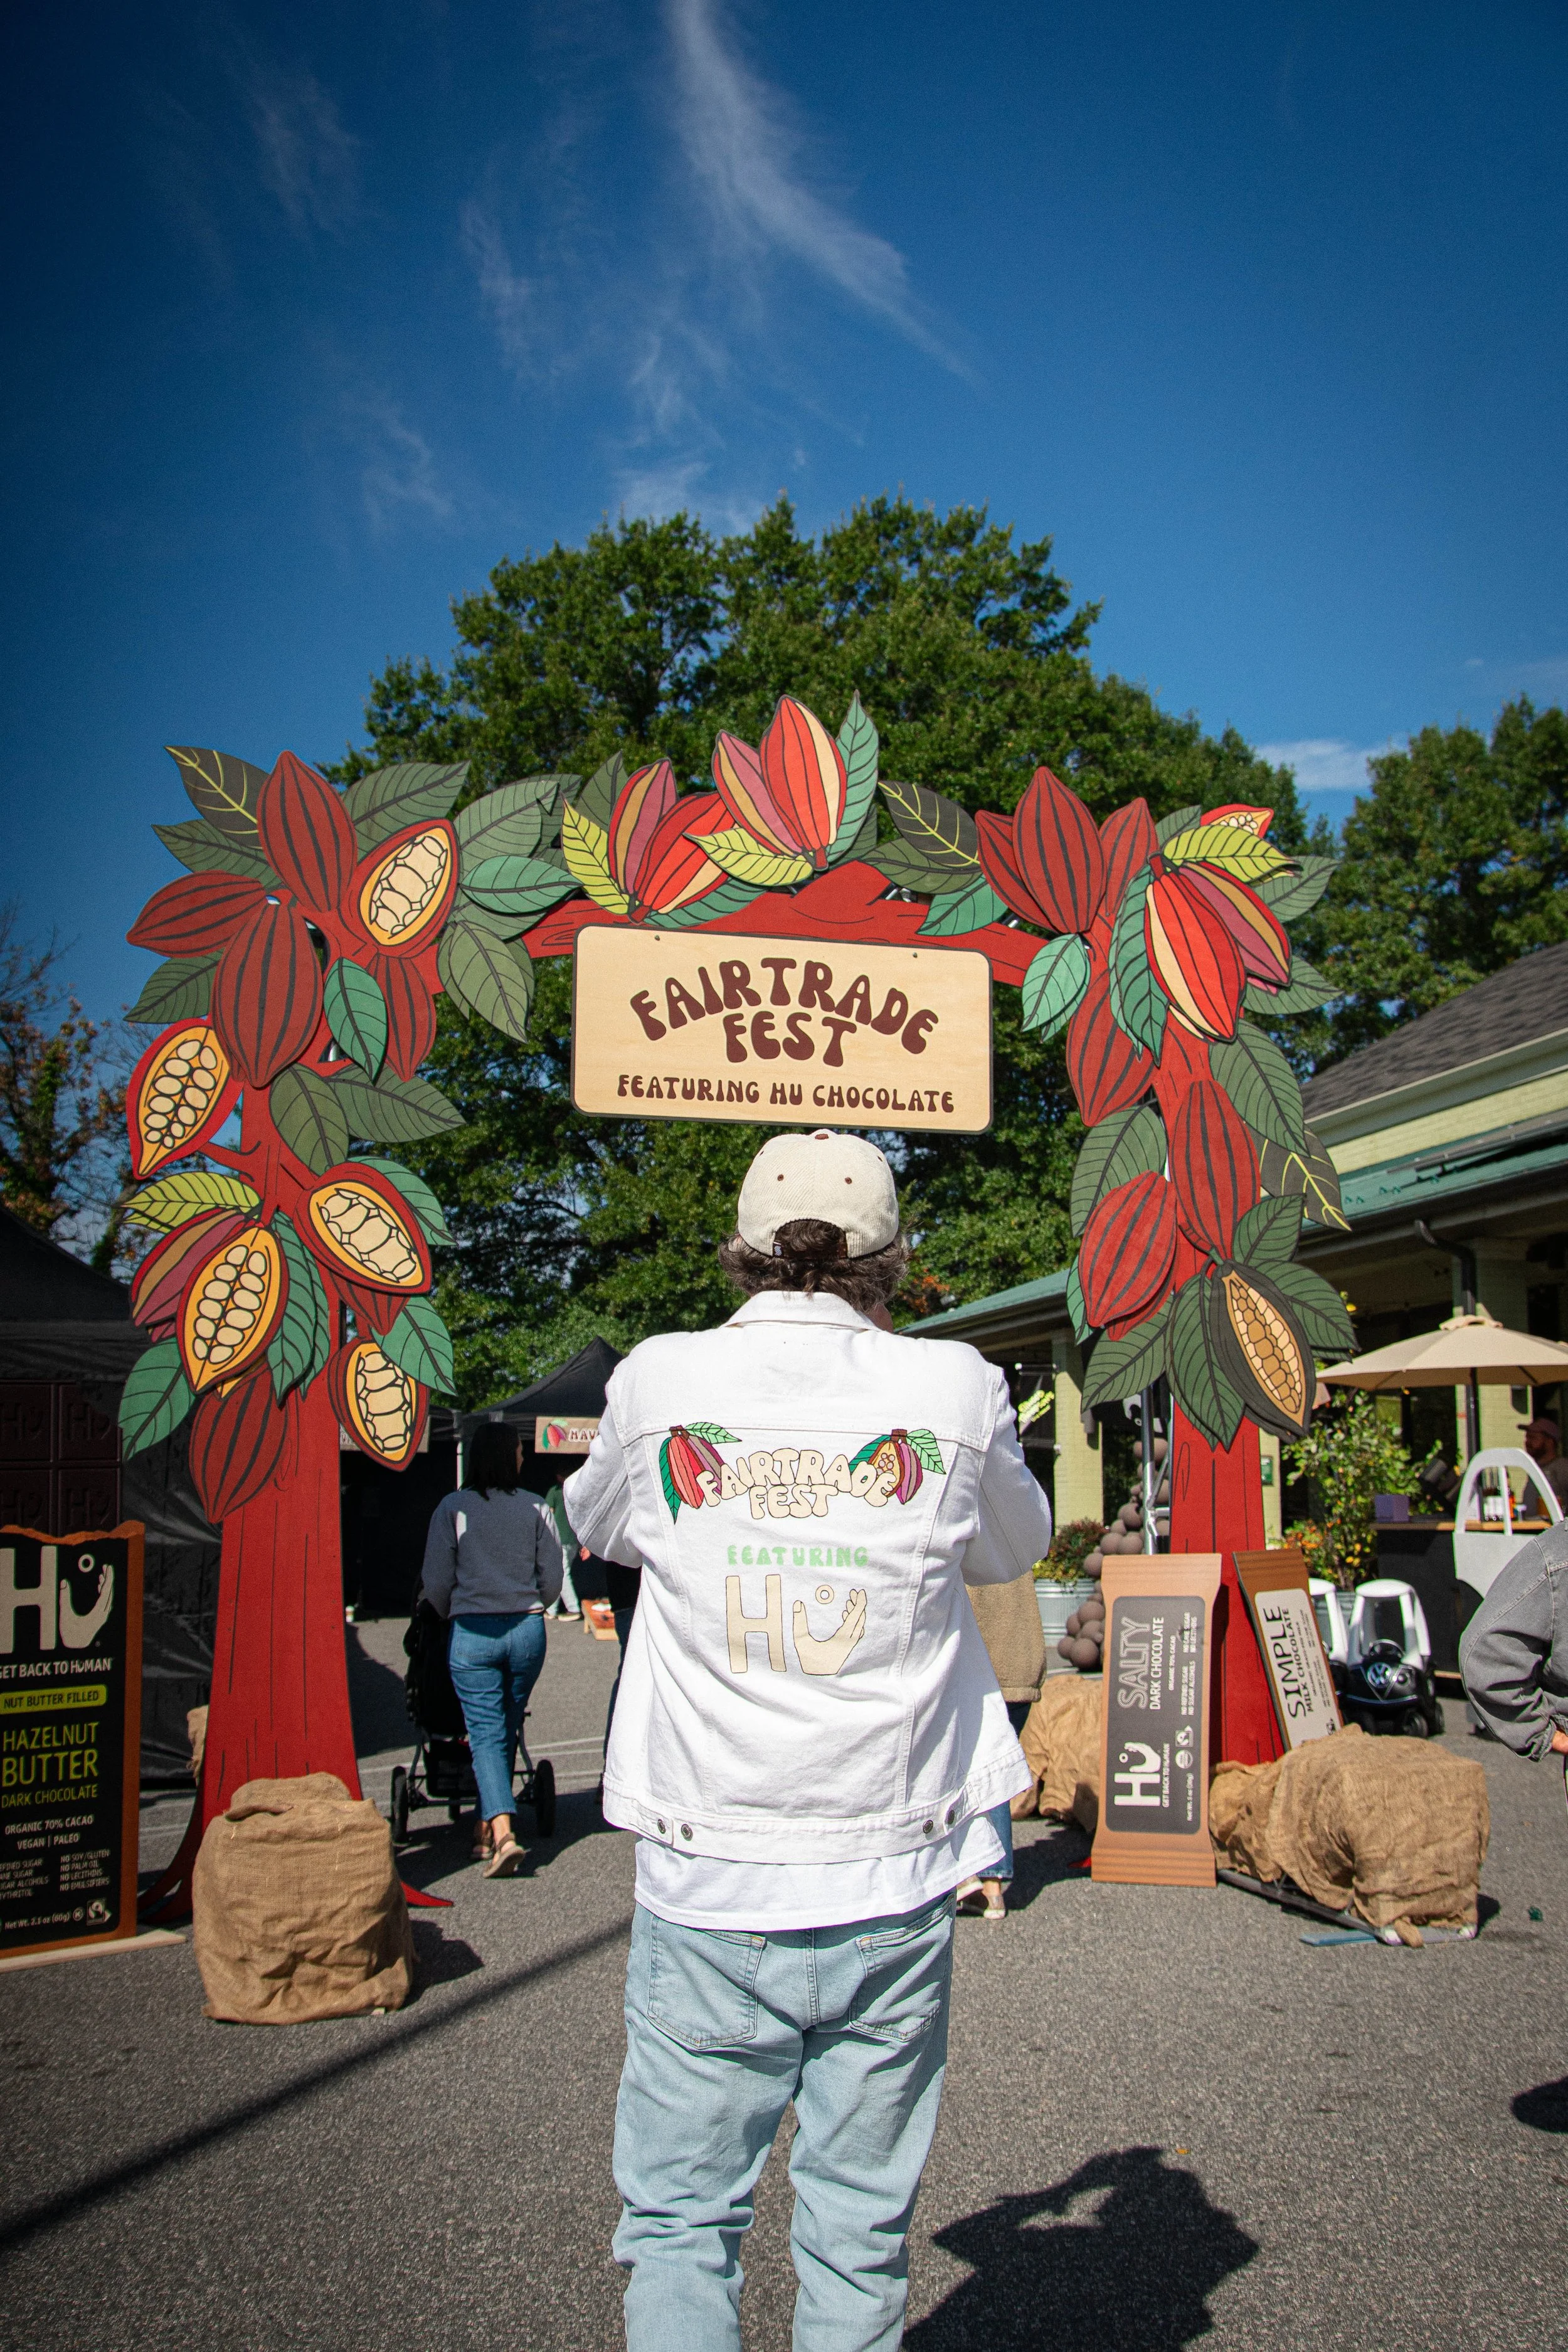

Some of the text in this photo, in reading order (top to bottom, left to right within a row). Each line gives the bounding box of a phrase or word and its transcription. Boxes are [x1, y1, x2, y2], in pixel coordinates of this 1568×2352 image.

[630, 958, 938, 1054] FAIRTRADE
[723, 1011, 857, 1067] FEST
[617, 1074, 954, 1113] FEATURING HU CHOCOLATE
[568, 1428, 600, 1442] HAV
[696, 1448, 897, 1507] FAIRTRADE
[748, 1484, 839, 1519] FEST
[726, 1545, 869, 1567] FEATURING
[19, 1662, 50, 1678] BACK
[53, 1661, 67, 1675] TO
[1118, 1616, 1150, 1709] SALTY
[1150, 1617, 1164, 1710] DARK CHOCOLATE
[1263, 1606, 1306, 1718] SIMPLE
[1282, 1608, 1314, 1712] MILK CHOCOLATE
[4, 1691, 99, 1708] NUT BUTTER FILLED
[3, 1722, 99, 1751] HAZELNUT
[2, 1749, 98, 1787] BUTTER
[1, 1784, 98, 1809] DARK CHOCOLATE
[5, 1815, 93, 1835] ORGANIC 70% CACAO
[17, 1836, 45, 1850] VEGAN
[54, 1833, 80, 1846] PALEO
[23, 1857, 44, 1868] SUGAR
[60, 1855, 70, 1863] NO
[60, 1863, 70, 1872] NO
[72, 1862, 88, 1871] PALM
[0, 1868, 34, 1880] ANE SUGAR
[60, 1873, 70, 1882] NO
[60, 1882, 70, 1892] NO
[4, 1921, 17, 1930] Net
[31, 1916, 41, 1926] 2.1
